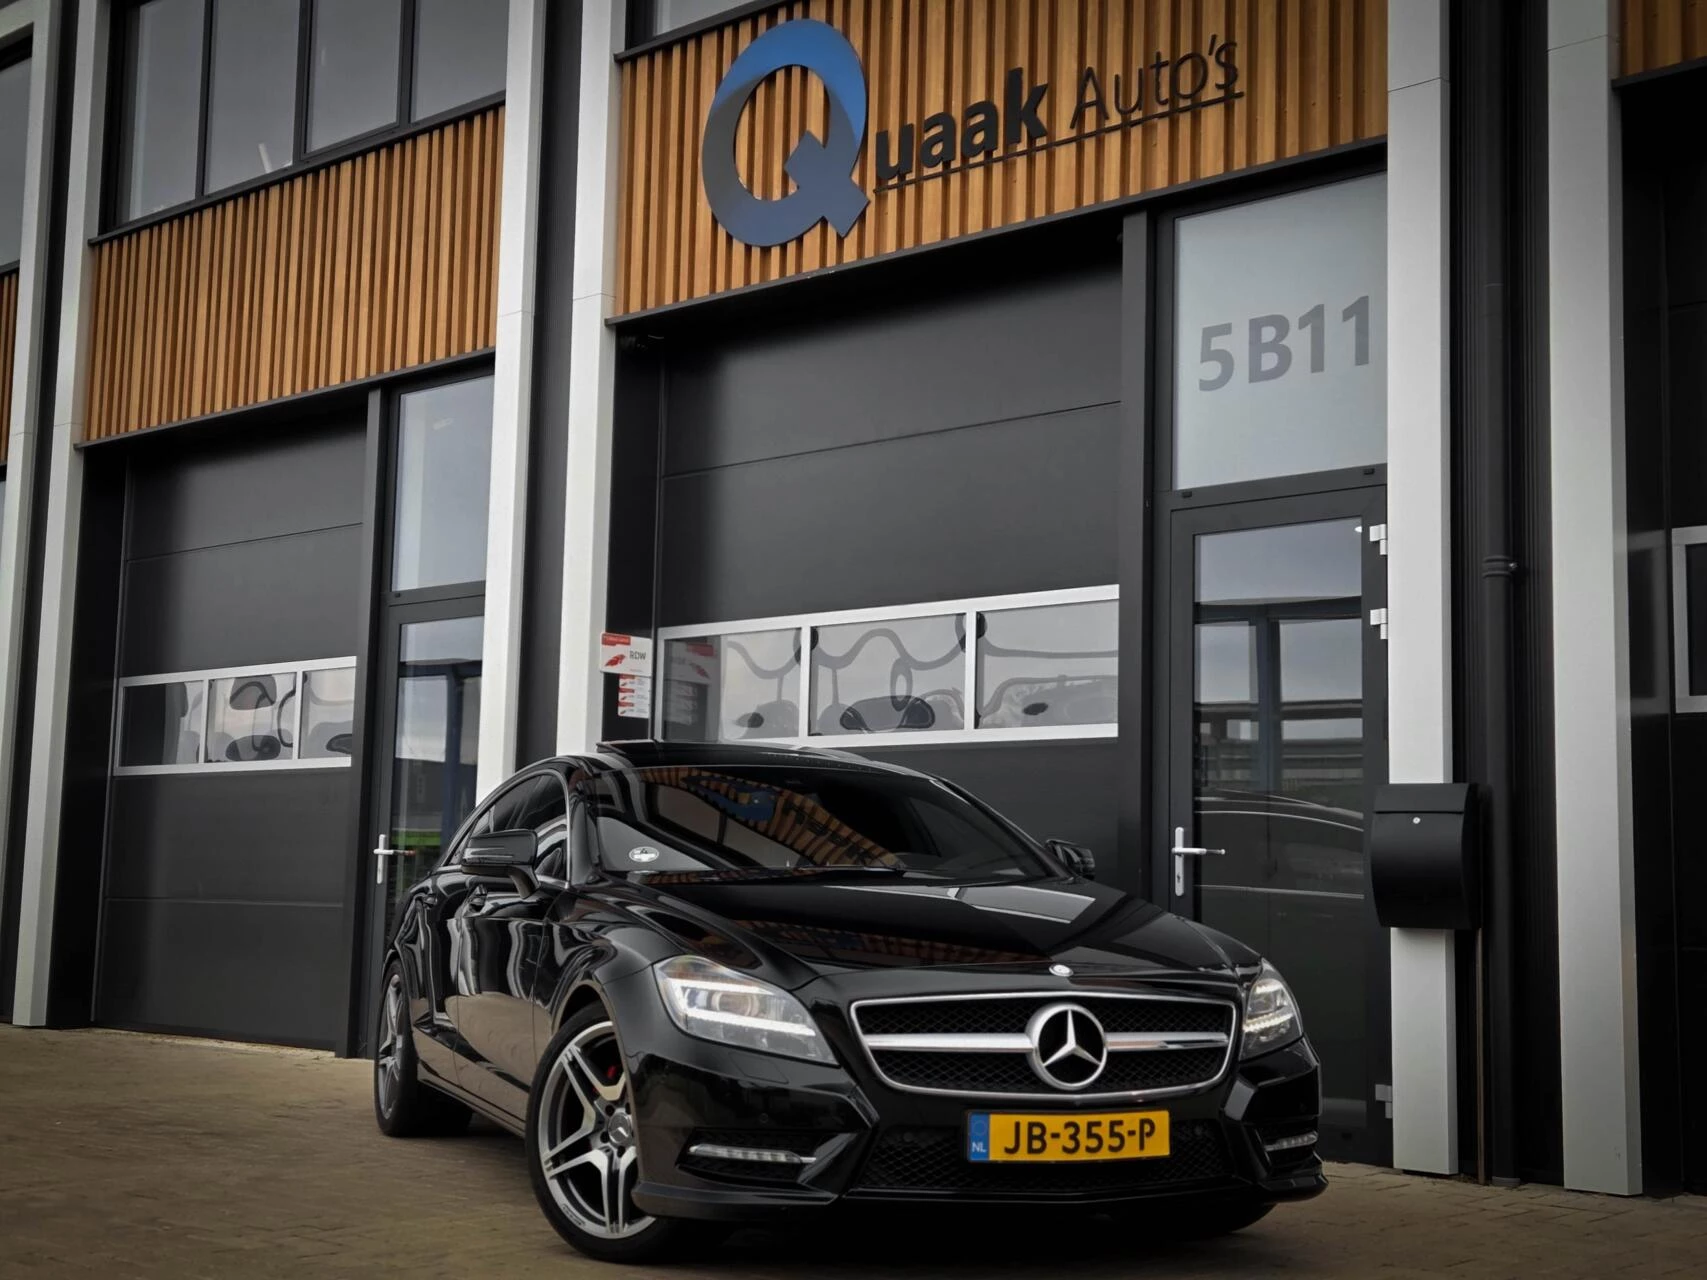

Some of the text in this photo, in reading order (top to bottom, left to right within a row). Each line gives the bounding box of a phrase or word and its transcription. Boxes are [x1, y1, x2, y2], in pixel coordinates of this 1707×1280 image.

[701, 18, 1239, 247] Quaak Auto's
[1198, 295, 1369, 392] 5B11
[629, 650, 647, 660] RDW
[971, 1142, 986, 1153] NL
[1004, 1118, 1156, 1155] JB-355-P
